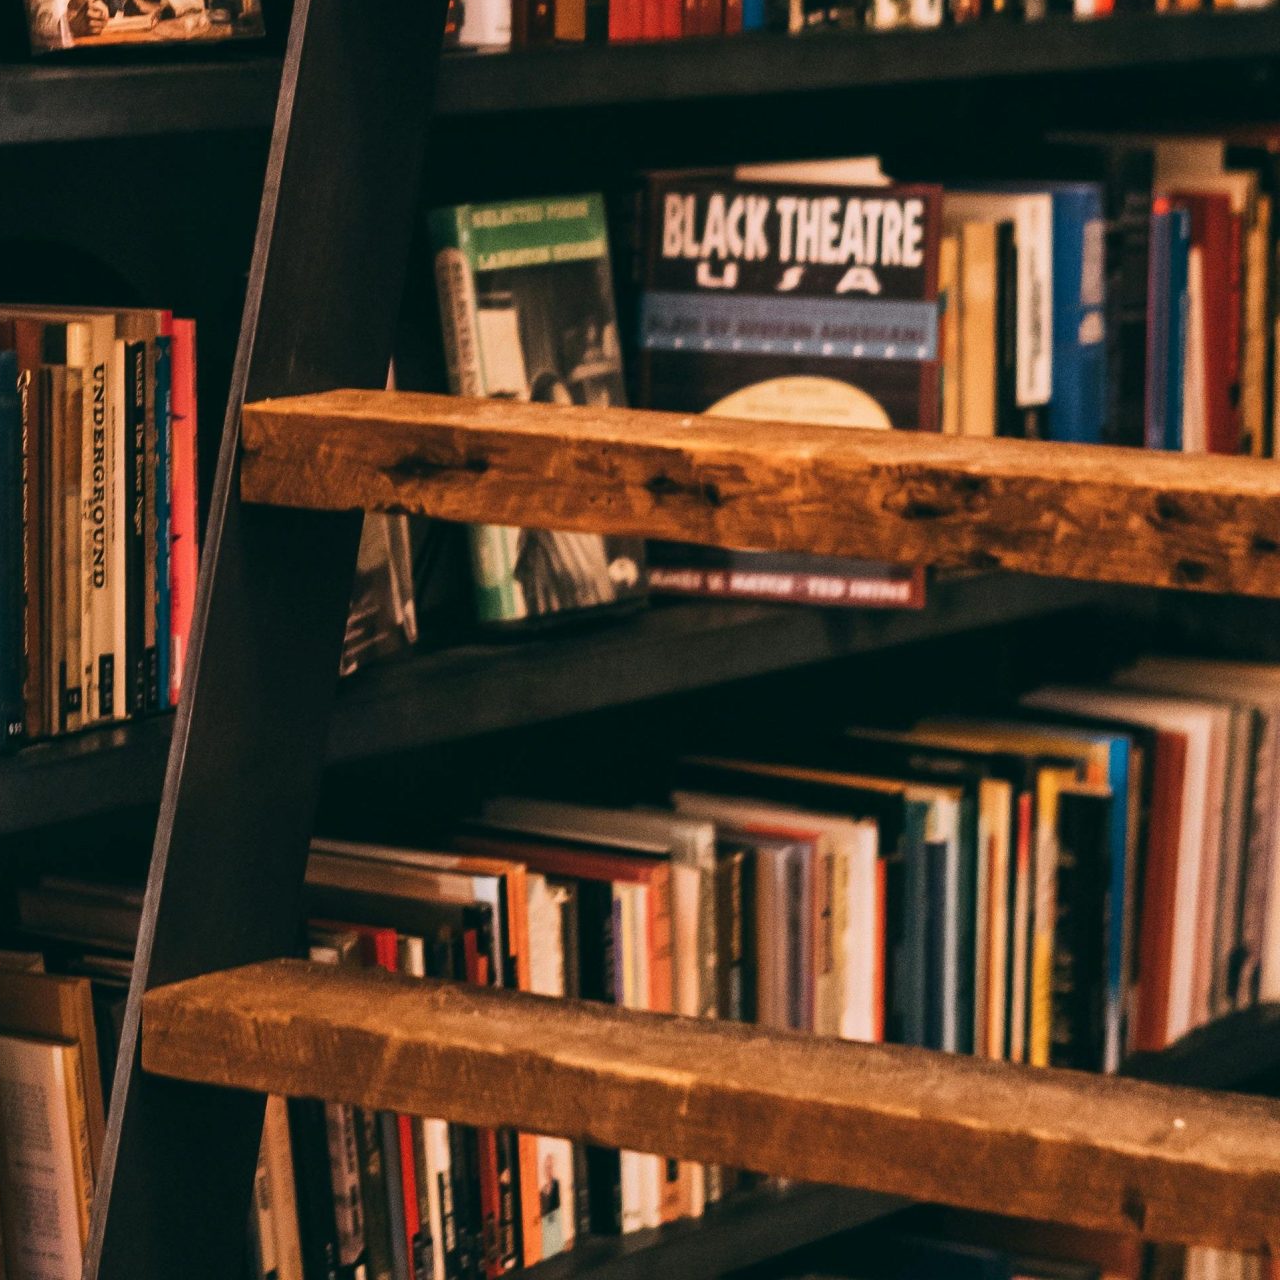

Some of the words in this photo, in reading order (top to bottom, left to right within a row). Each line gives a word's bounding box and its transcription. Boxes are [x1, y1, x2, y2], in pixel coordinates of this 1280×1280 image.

[662, 193, 769, 262] BLACK
[774, 198, 925, 268] THEATRE
[835, 265, 882, 296] A
[135, 351, 144, 408] WALKER
[135, 423, 144, 449] The
[92, 362, 106, 590] UNDERGROUND
[135, 453, 144, 493] River
[133, 496, 144, 537] Niger
